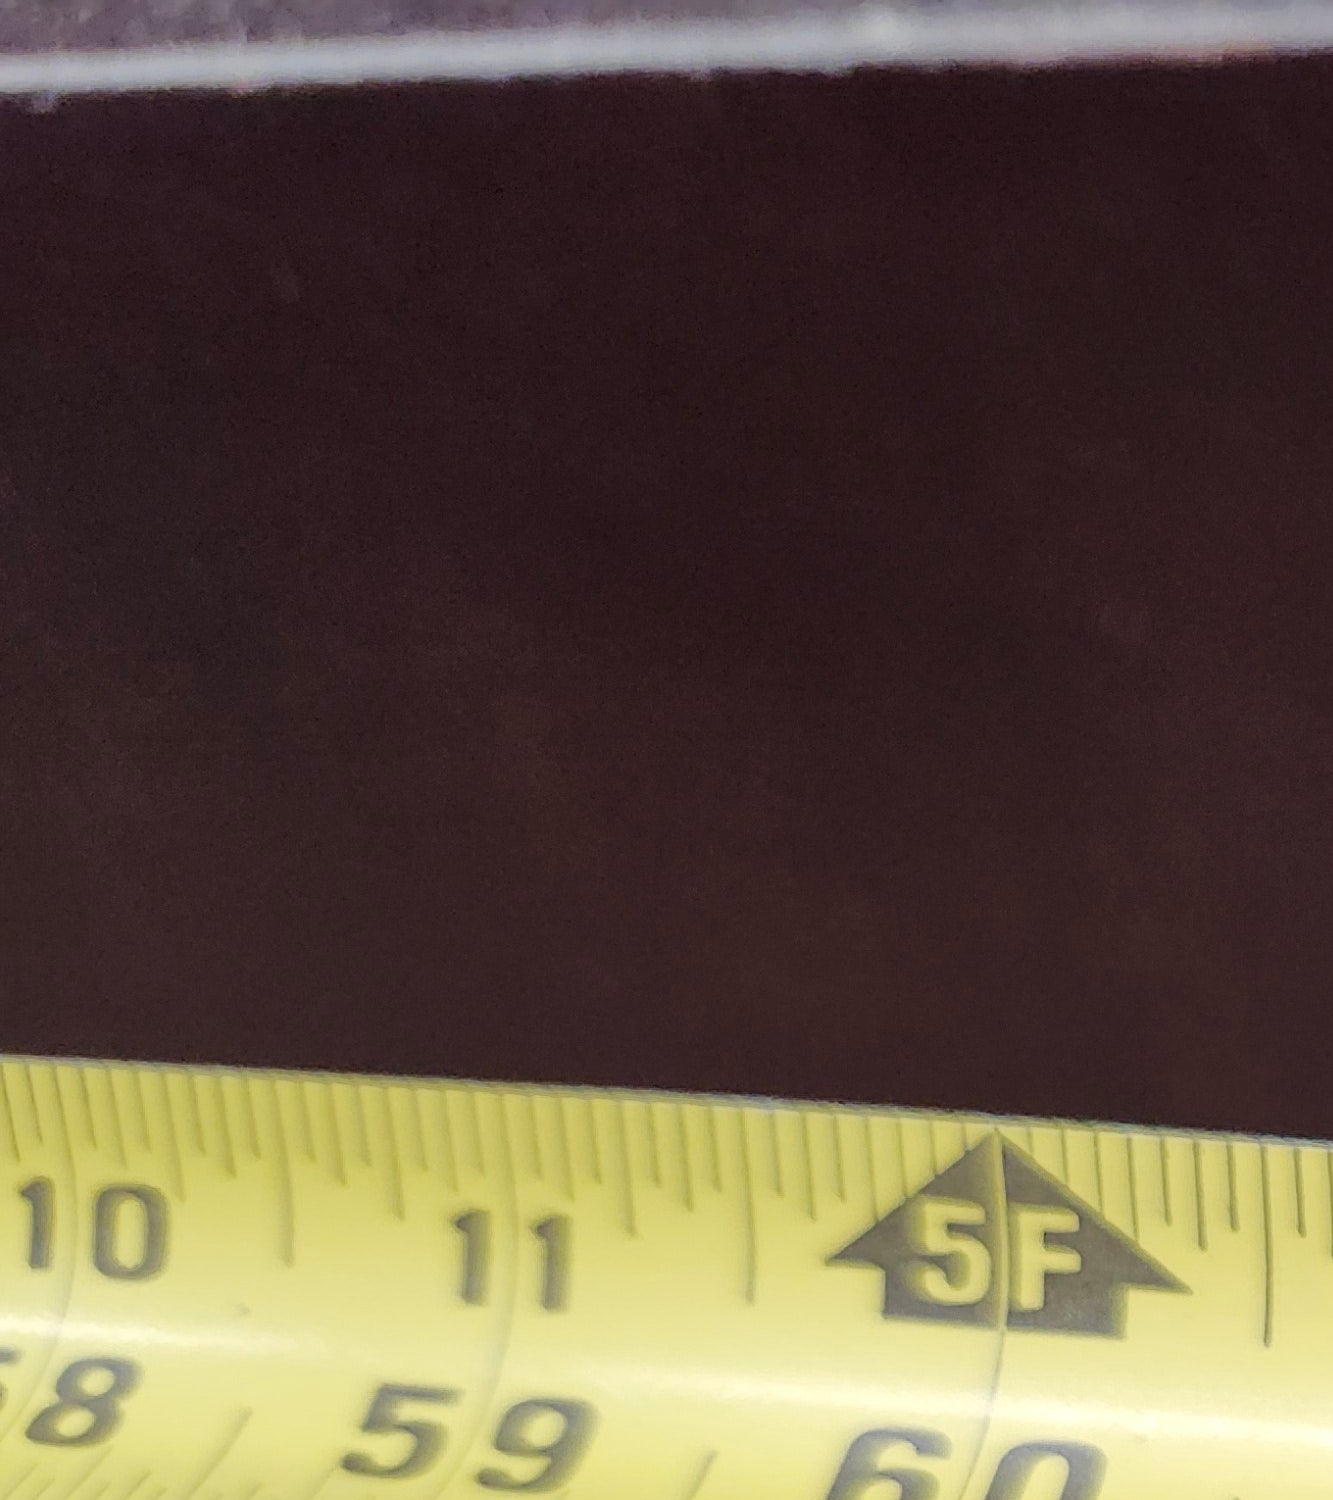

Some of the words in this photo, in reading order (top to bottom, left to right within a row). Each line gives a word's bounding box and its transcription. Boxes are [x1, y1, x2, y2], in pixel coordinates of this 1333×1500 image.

[19, 1175, 170, 1281] 10
[451, 1208, 573, 1312] 11
[910, 1199, 1083, 1313] 5F
[0, 1346, 140, 1447] 8
[340, 1382, 602, 1494] 59
